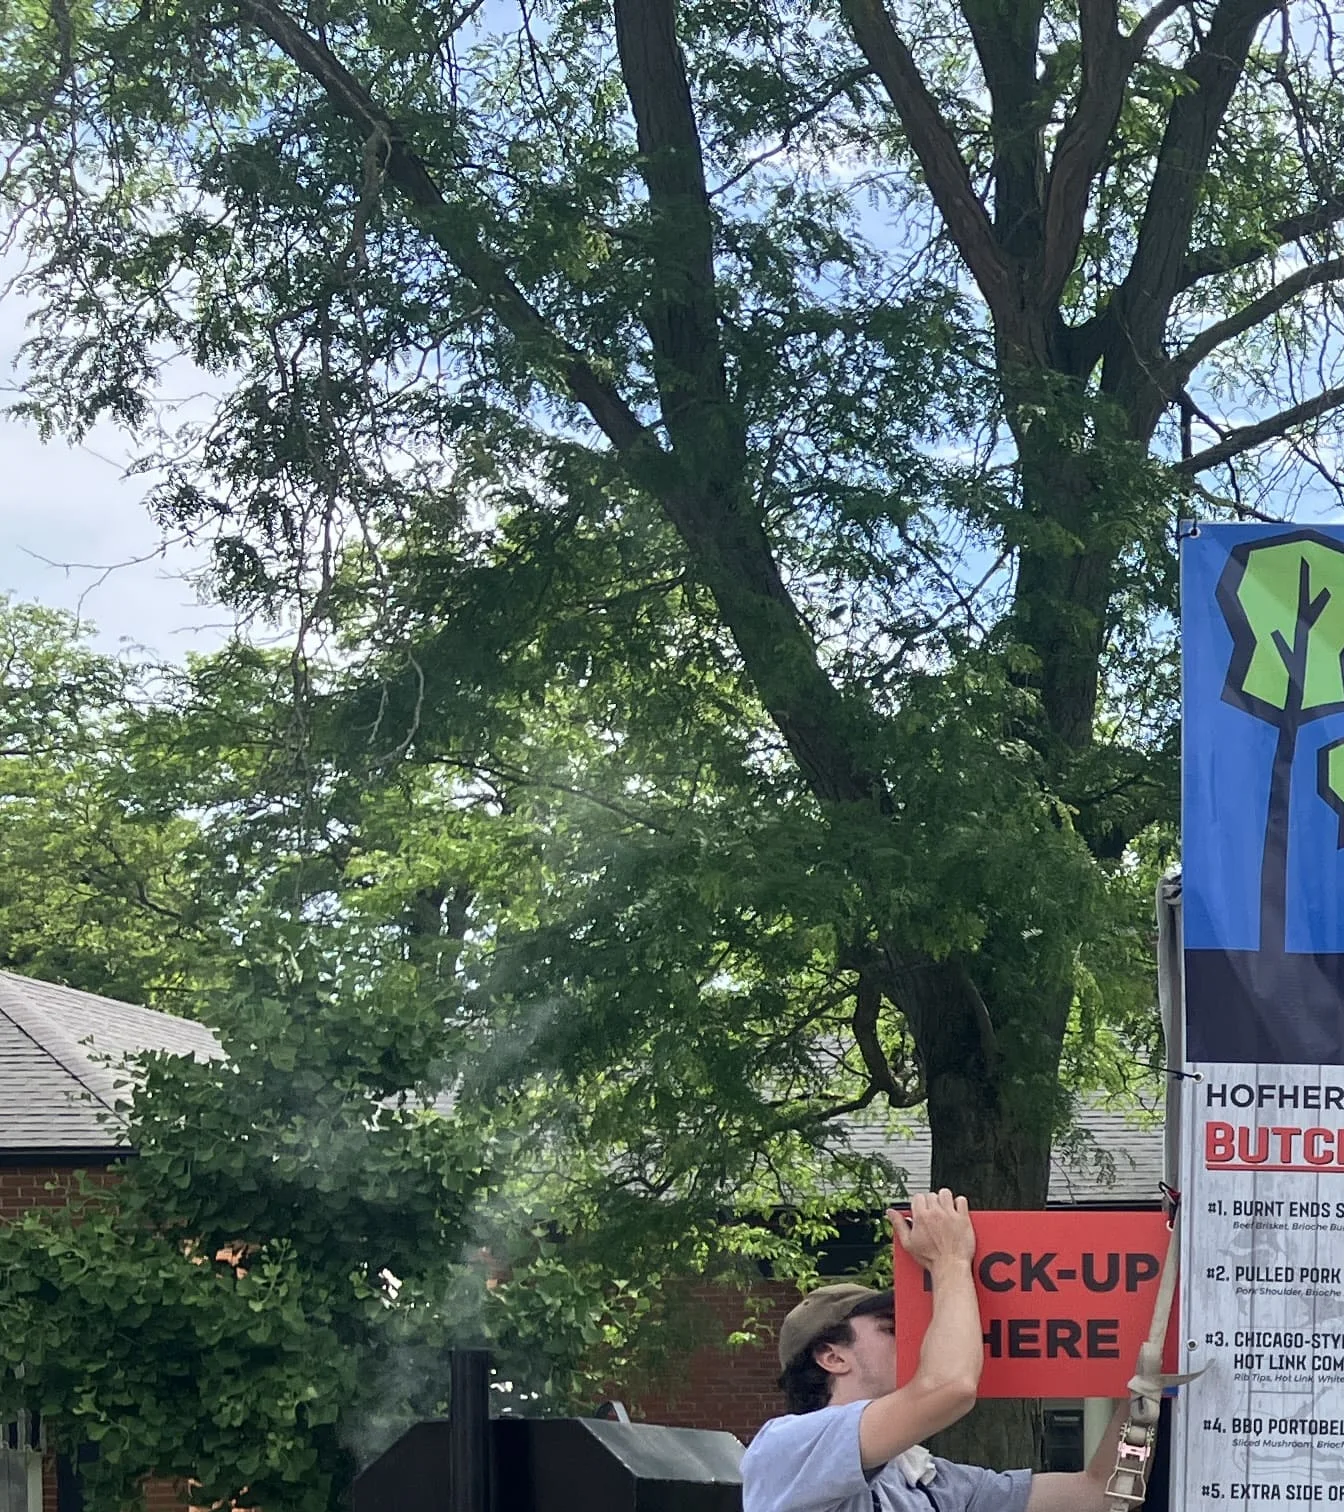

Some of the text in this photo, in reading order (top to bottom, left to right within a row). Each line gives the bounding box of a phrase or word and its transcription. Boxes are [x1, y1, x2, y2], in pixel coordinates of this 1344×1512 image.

[1208, 1200, 1227, 1216] #1.
[1233, 1200, 1284, 1217] BURNT
[1289, 1202, 1330, 1218] ENDS
[924, 1252, 1160, 1293] CK-UP
[1207, 1266, 1229, 1282] #2.
[1235, 1266, 1294, 1282] PULLED
[1300, 1267, 1341, 1284] PORK
[1236, 1287, 1257, 1296] Pork
[1305, 1288, 1341, 1297] Brioche
[983, 1319, 1120, 1359] HERE
[1205, 1331, 1229, 1347] #3.
[1234, 1353, 1264, 1370] HOT
[1269, 1354, 1306, 1371] LINK
[1234, 1373, 1250, 1382] Rib
[1275, 1374, 1292, 1382] Hot
[1318, 1375, 1344, 1384] White
[1203, 1418, 1226, 1434] #4.
[1232, 1418, 1263, 1436] BBQ
[1202, 1485, 1225, 1500] #5.
[1231, 1485, 1281, 1501] EXTRA
[1286, 1485, 1323, 1501] SIDE
